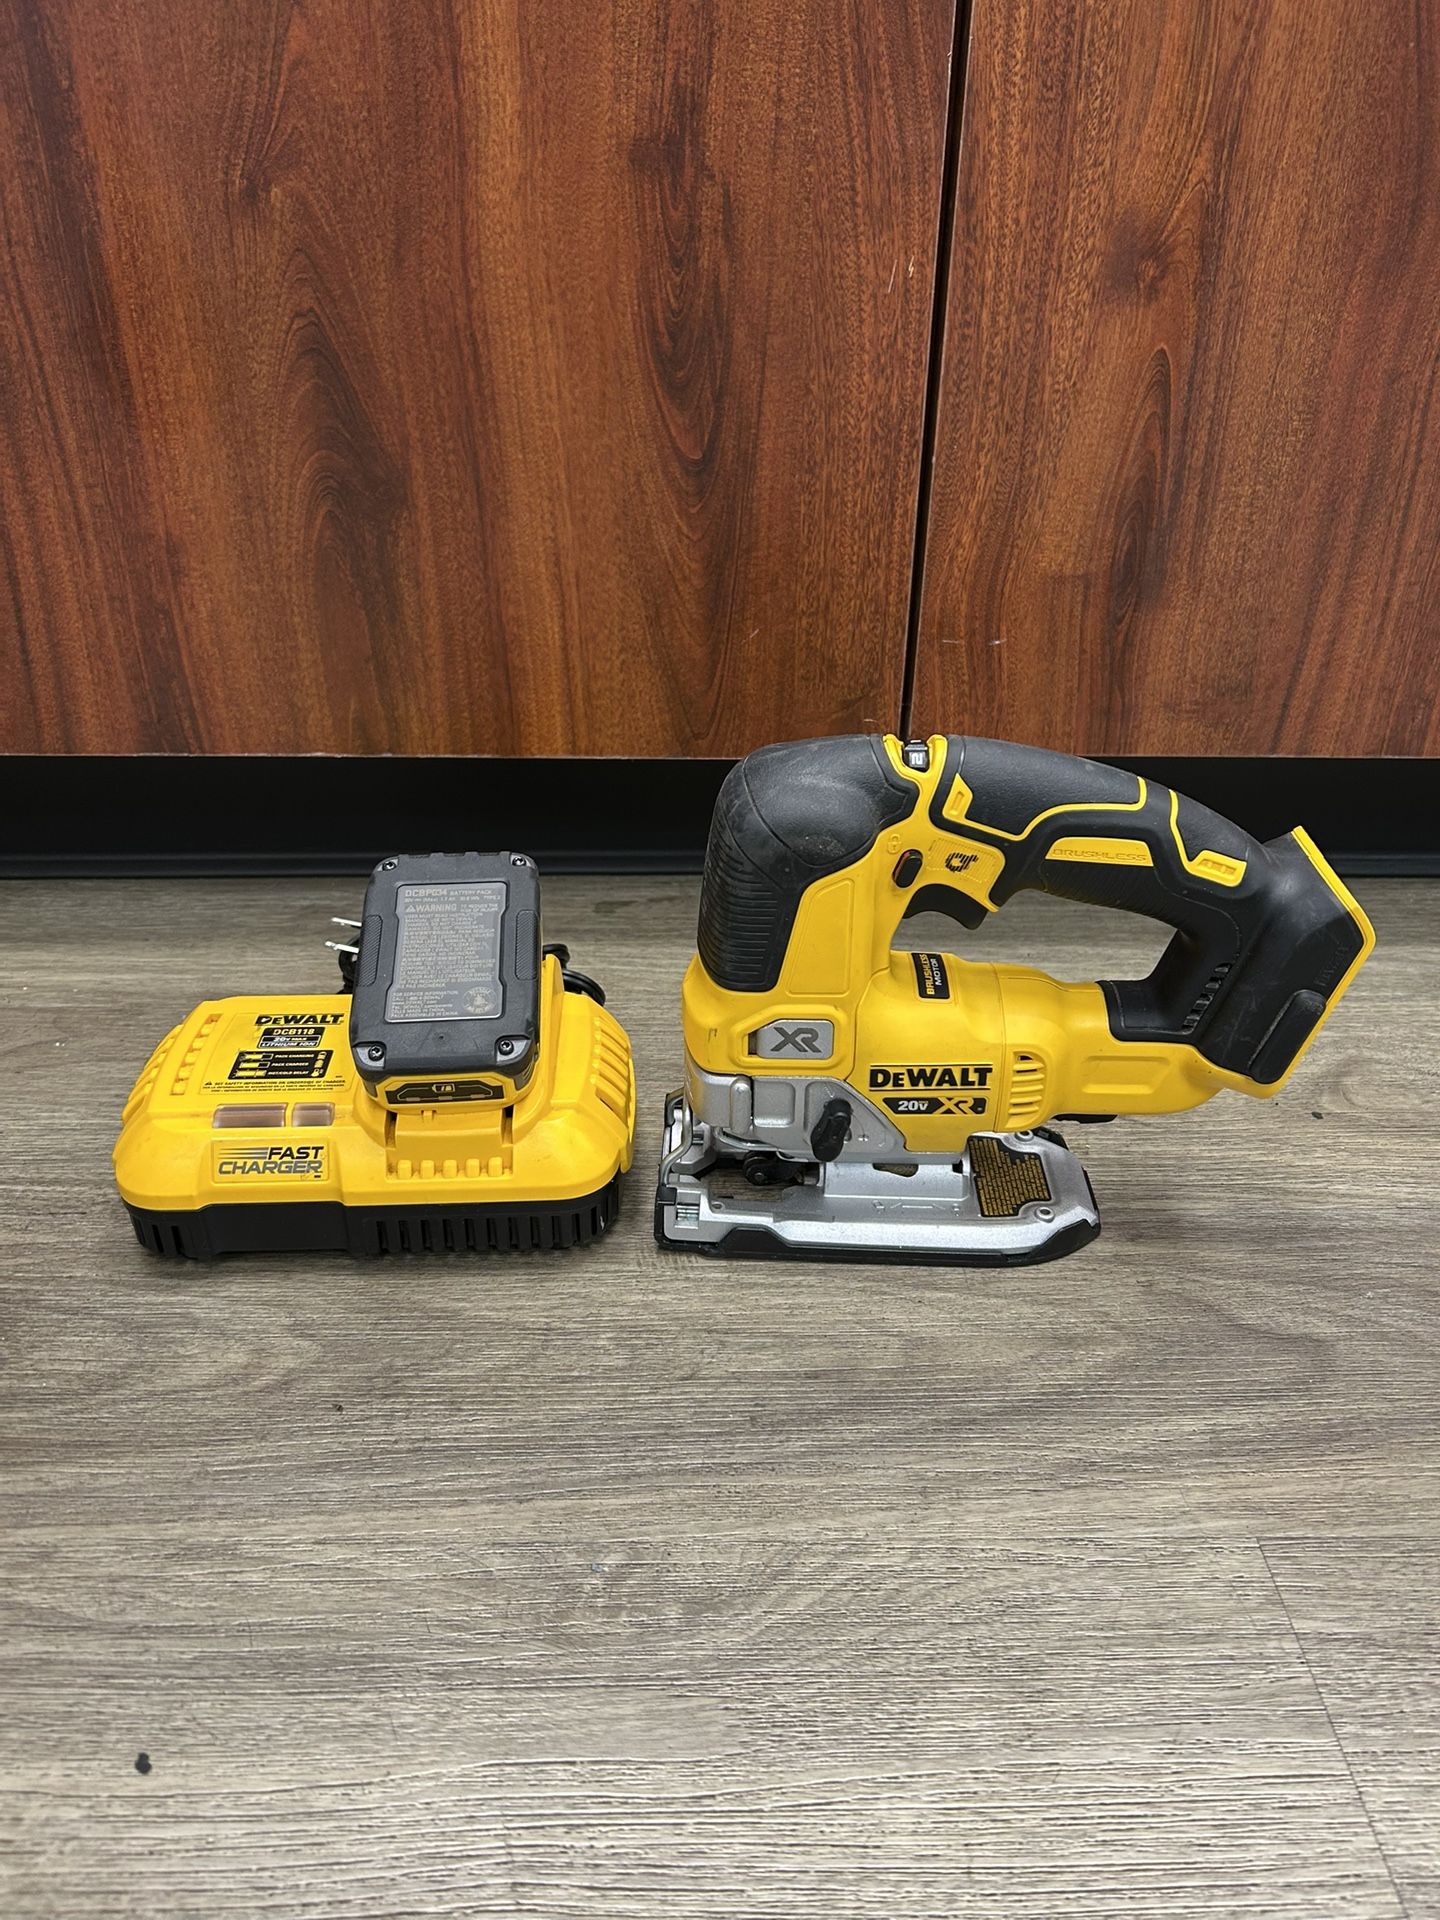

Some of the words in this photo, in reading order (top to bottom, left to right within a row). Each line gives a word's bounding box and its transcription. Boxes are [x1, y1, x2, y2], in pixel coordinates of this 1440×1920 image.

[1051, 847, 1148, 862] BRUSHLESS
[415, 903, 457, 912] WARNING
[919, 953, 936, 995] BRUSHLESS
[930, 958, 943, 986] MOTOR
[255, 1013, 344, 1025] DEWALT
[273, 1028, 315, 1036] DCB118
[770, 1026, 822, 1053] XR
[869, 1067, 993, 1088] DEWALT
[932, 1096, 975, 1115] XR
[268, 1146, 324, 1160] FAST
[218, 1160, 323, 1175] CHARGER
